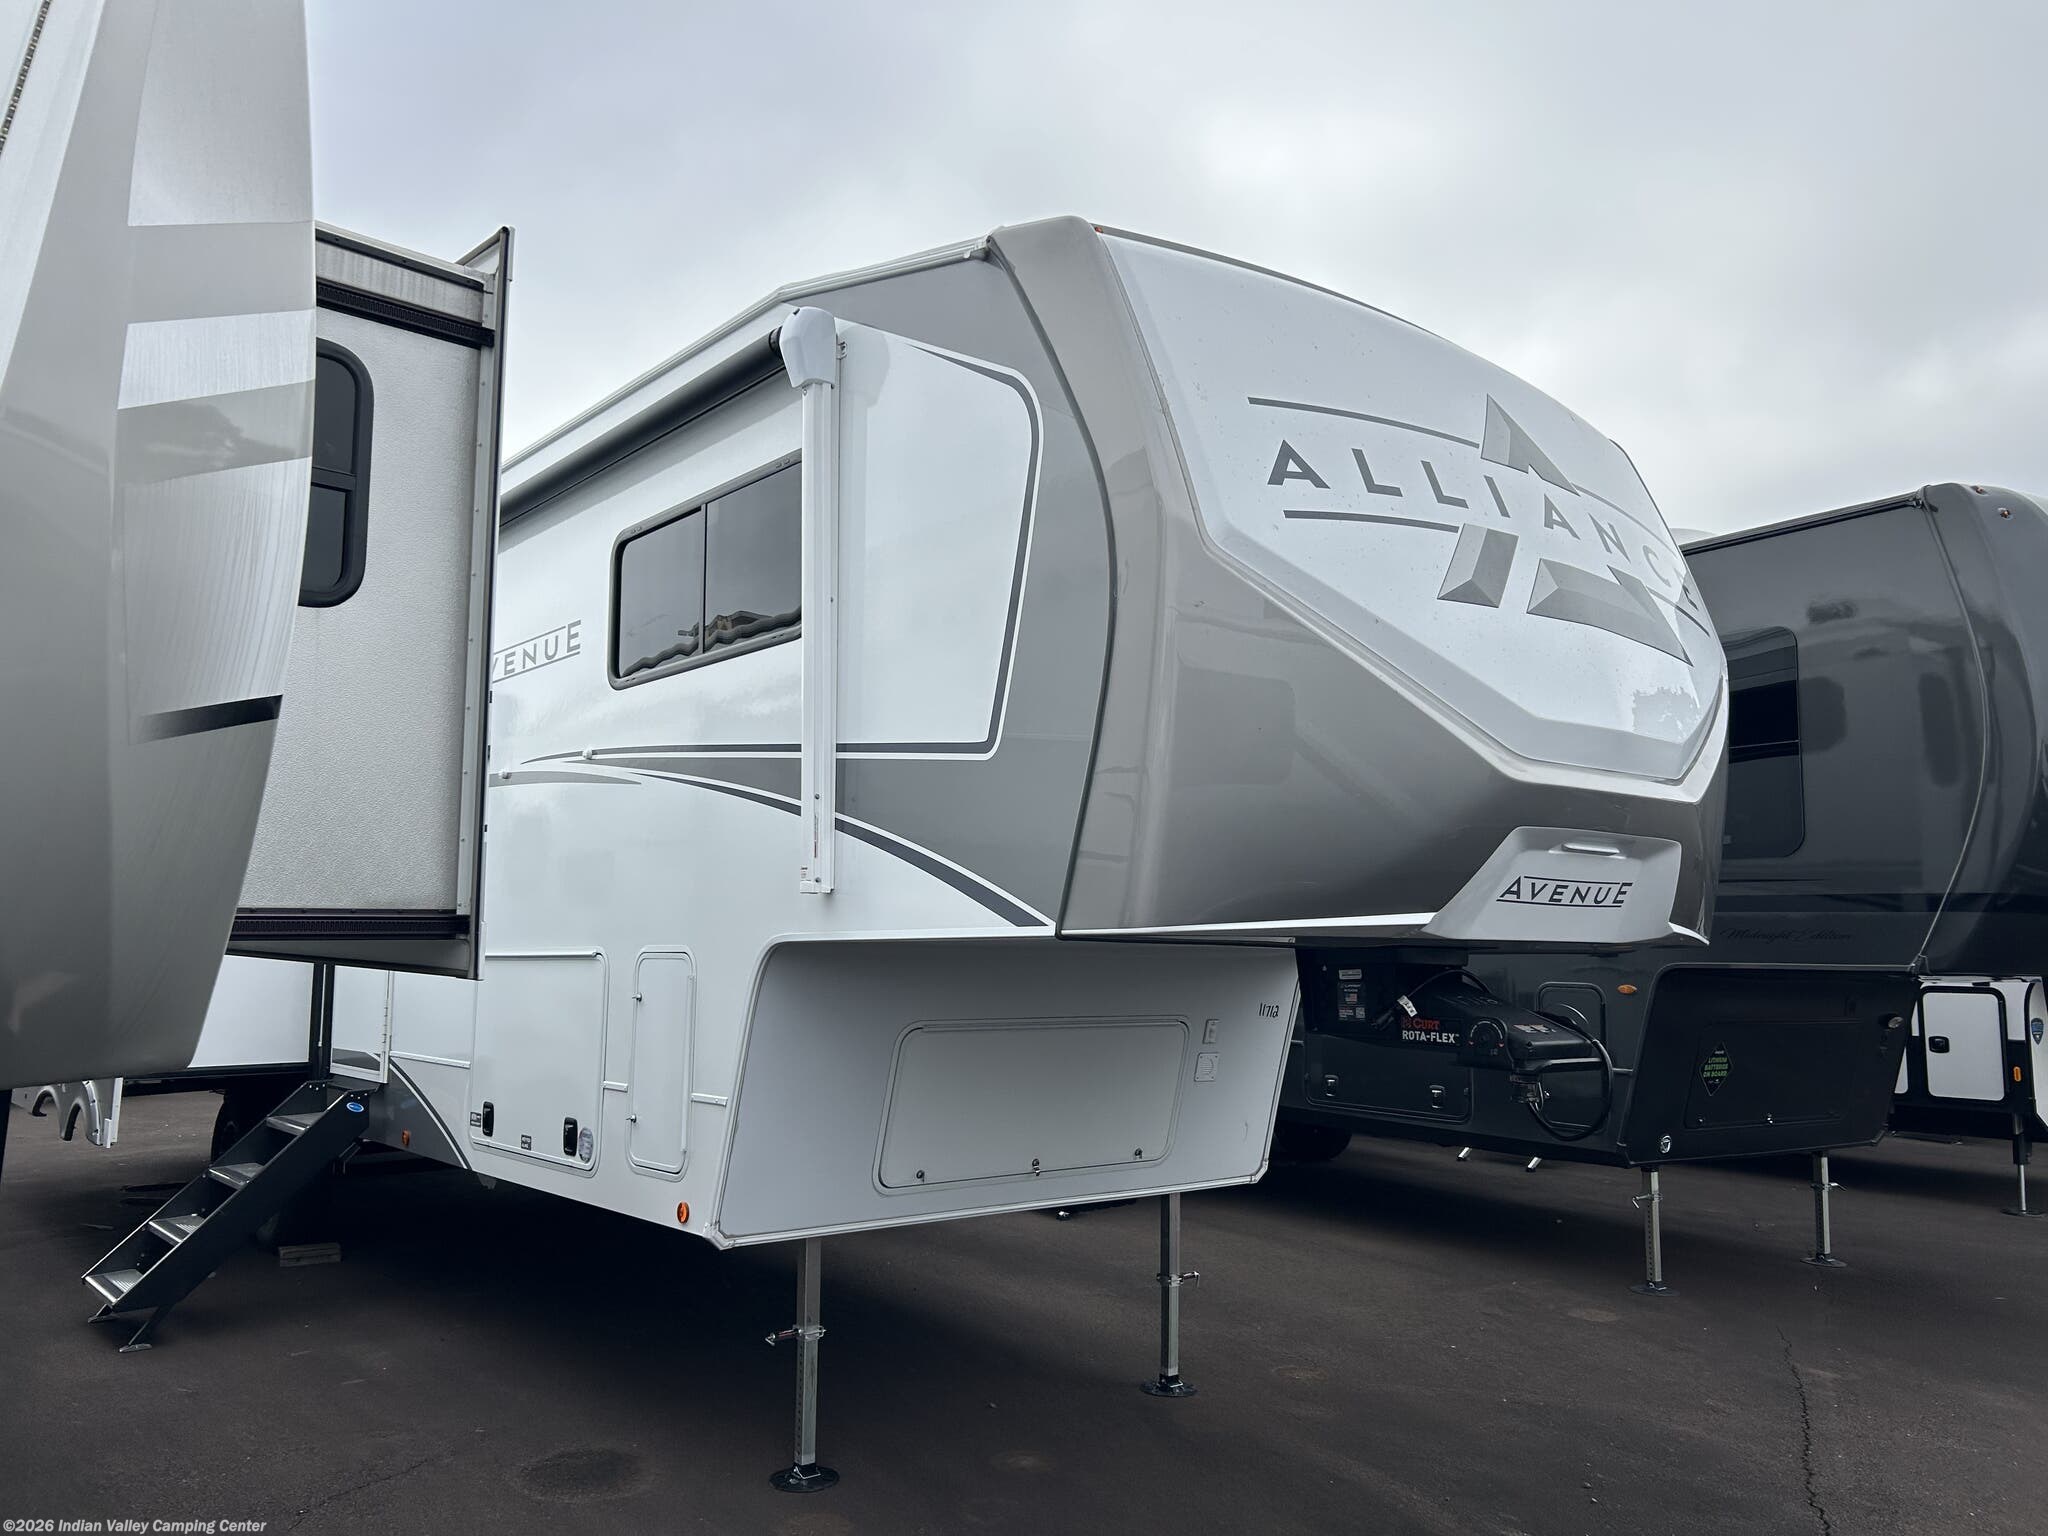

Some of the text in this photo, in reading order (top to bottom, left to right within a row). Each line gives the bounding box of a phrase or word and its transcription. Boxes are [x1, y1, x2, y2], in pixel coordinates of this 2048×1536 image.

[1267, 440, 1699, 612] ALLIANCE
[1499, 876, 1633, 905] AVENUE
[1413, 1018, 1440, 1030] CURT
